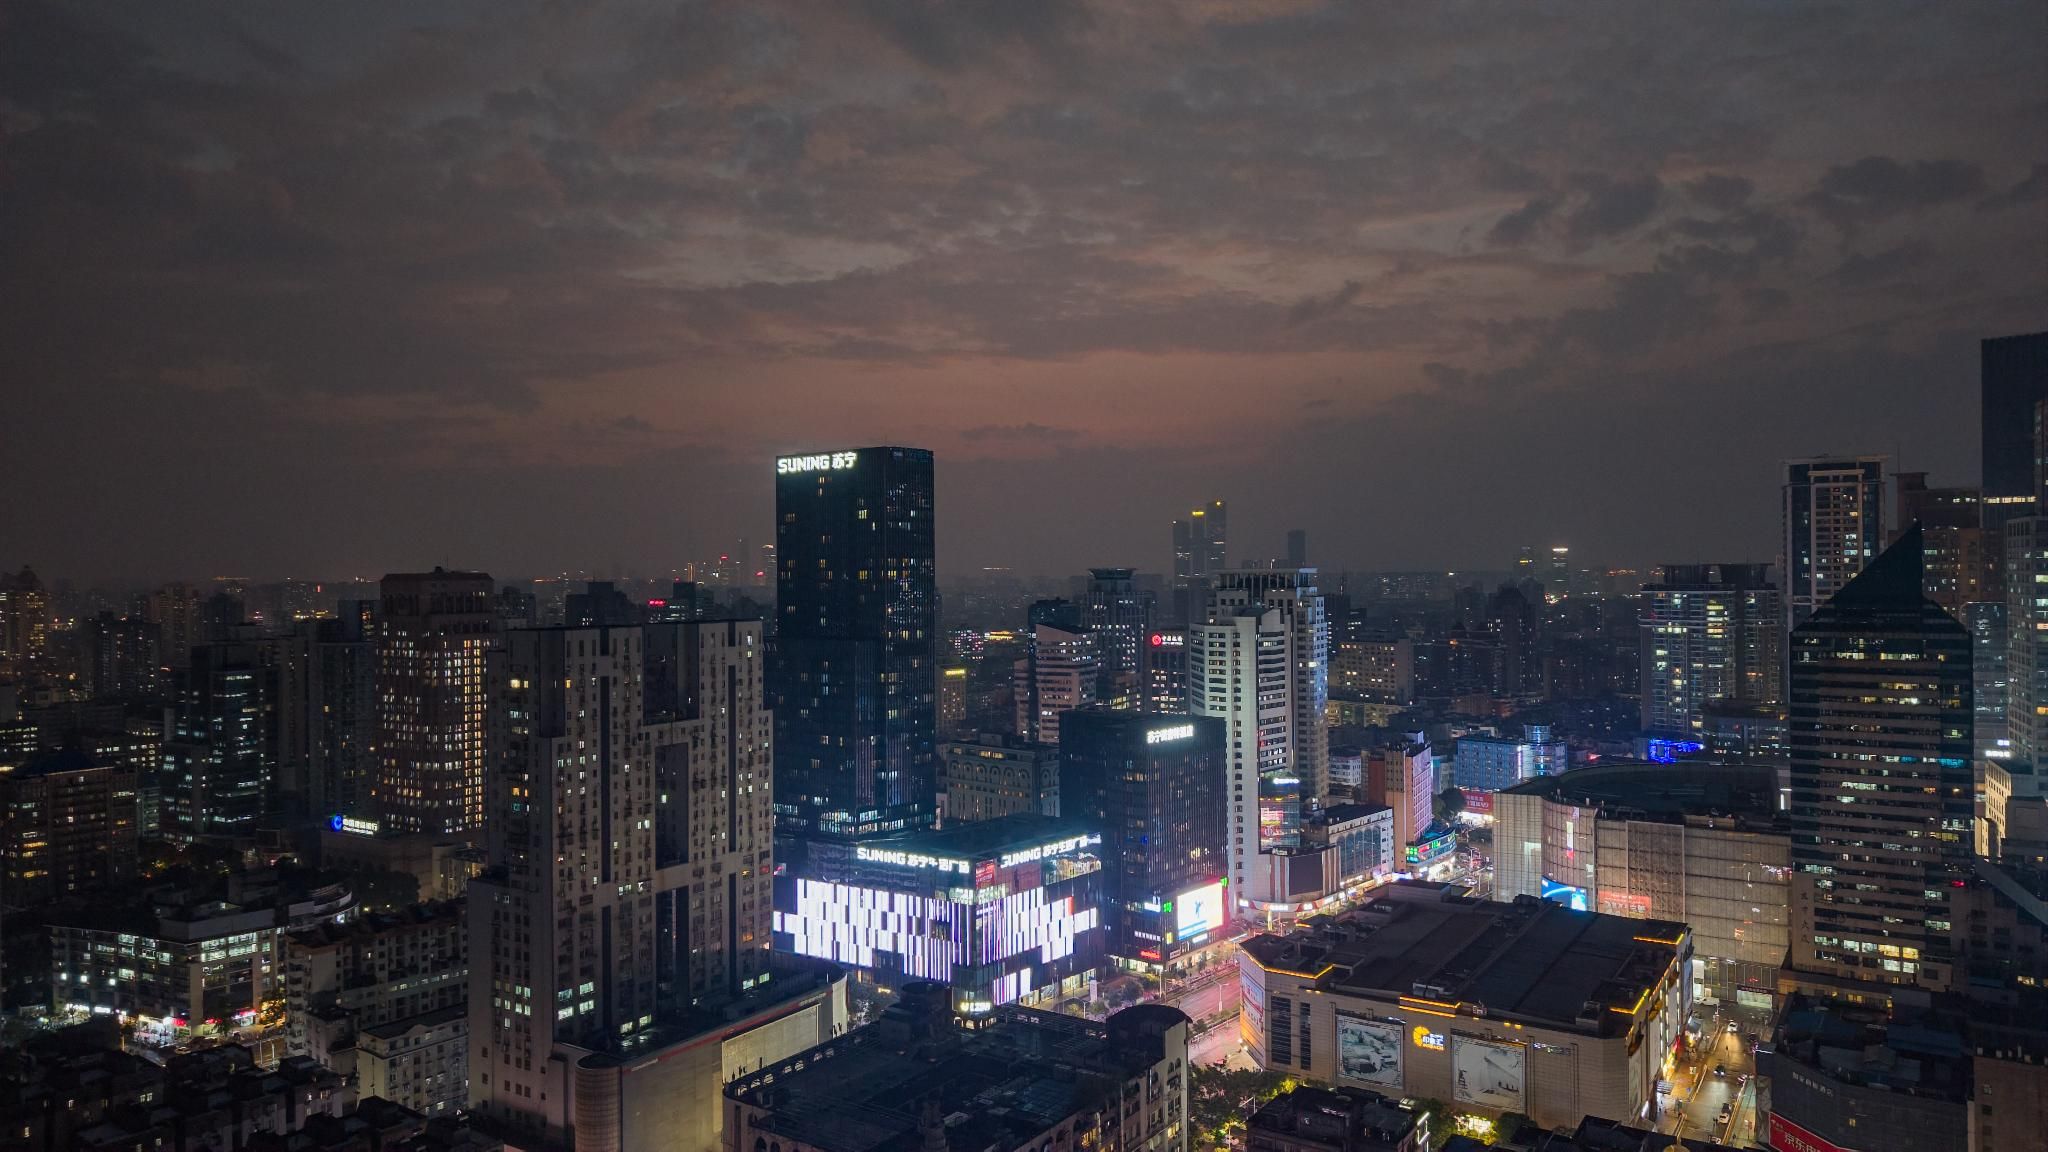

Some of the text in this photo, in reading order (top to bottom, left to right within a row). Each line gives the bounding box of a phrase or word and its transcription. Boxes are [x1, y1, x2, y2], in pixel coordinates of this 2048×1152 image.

[778, 452, 857, 474] SUNING 苏宁
[857, 847, 906, 865] SUNING
[1001, 846, 1041, 868] SUNING
